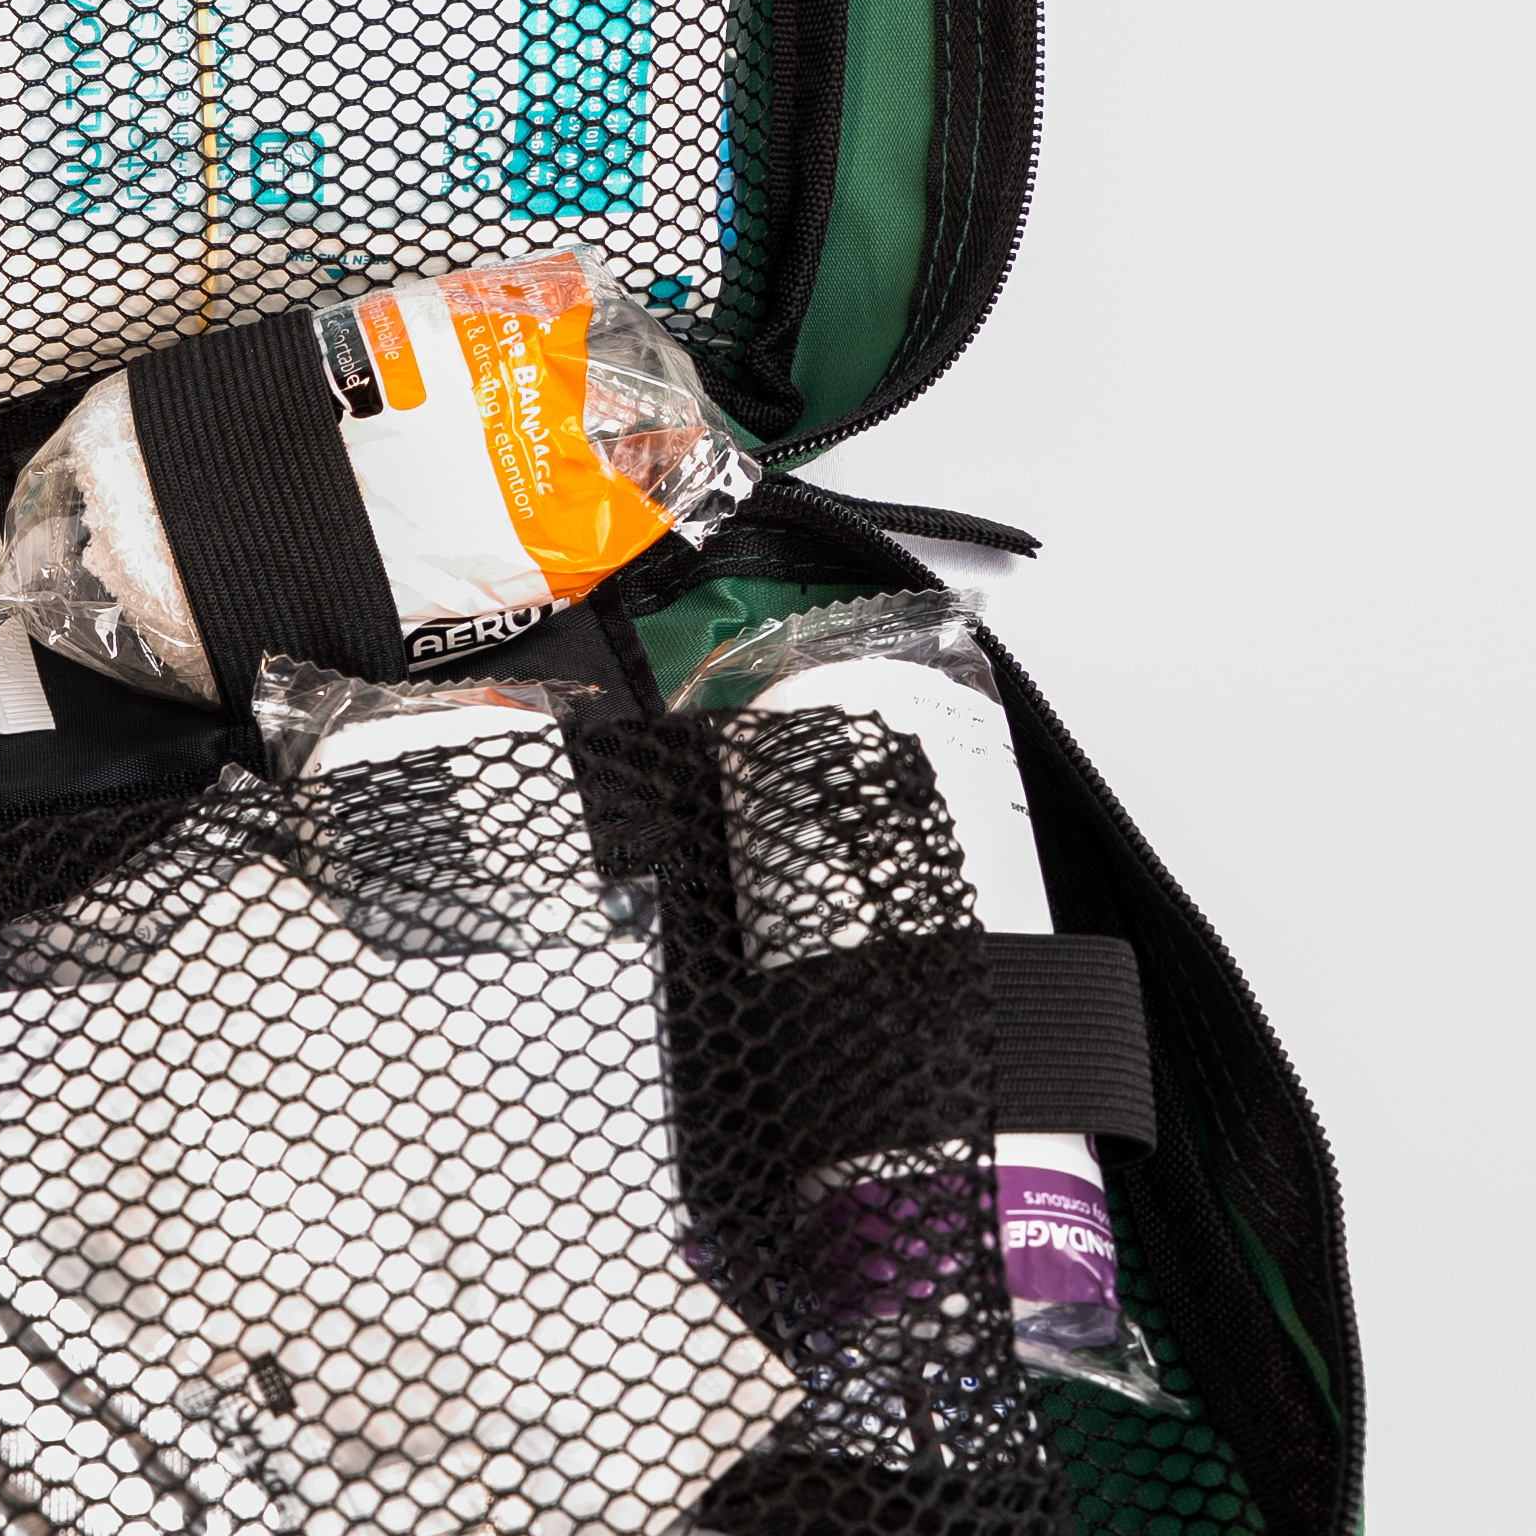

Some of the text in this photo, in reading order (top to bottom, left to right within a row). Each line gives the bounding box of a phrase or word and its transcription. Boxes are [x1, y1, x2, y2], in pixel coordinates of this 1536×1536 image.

[325, 311, 363, 390] fortable
[366, 296, 404, 361] reathable
[514, 364, 555, 496] BANDAGE
[492, 421, 535, 520] retention
[412, 605, 542, 658] AERO
